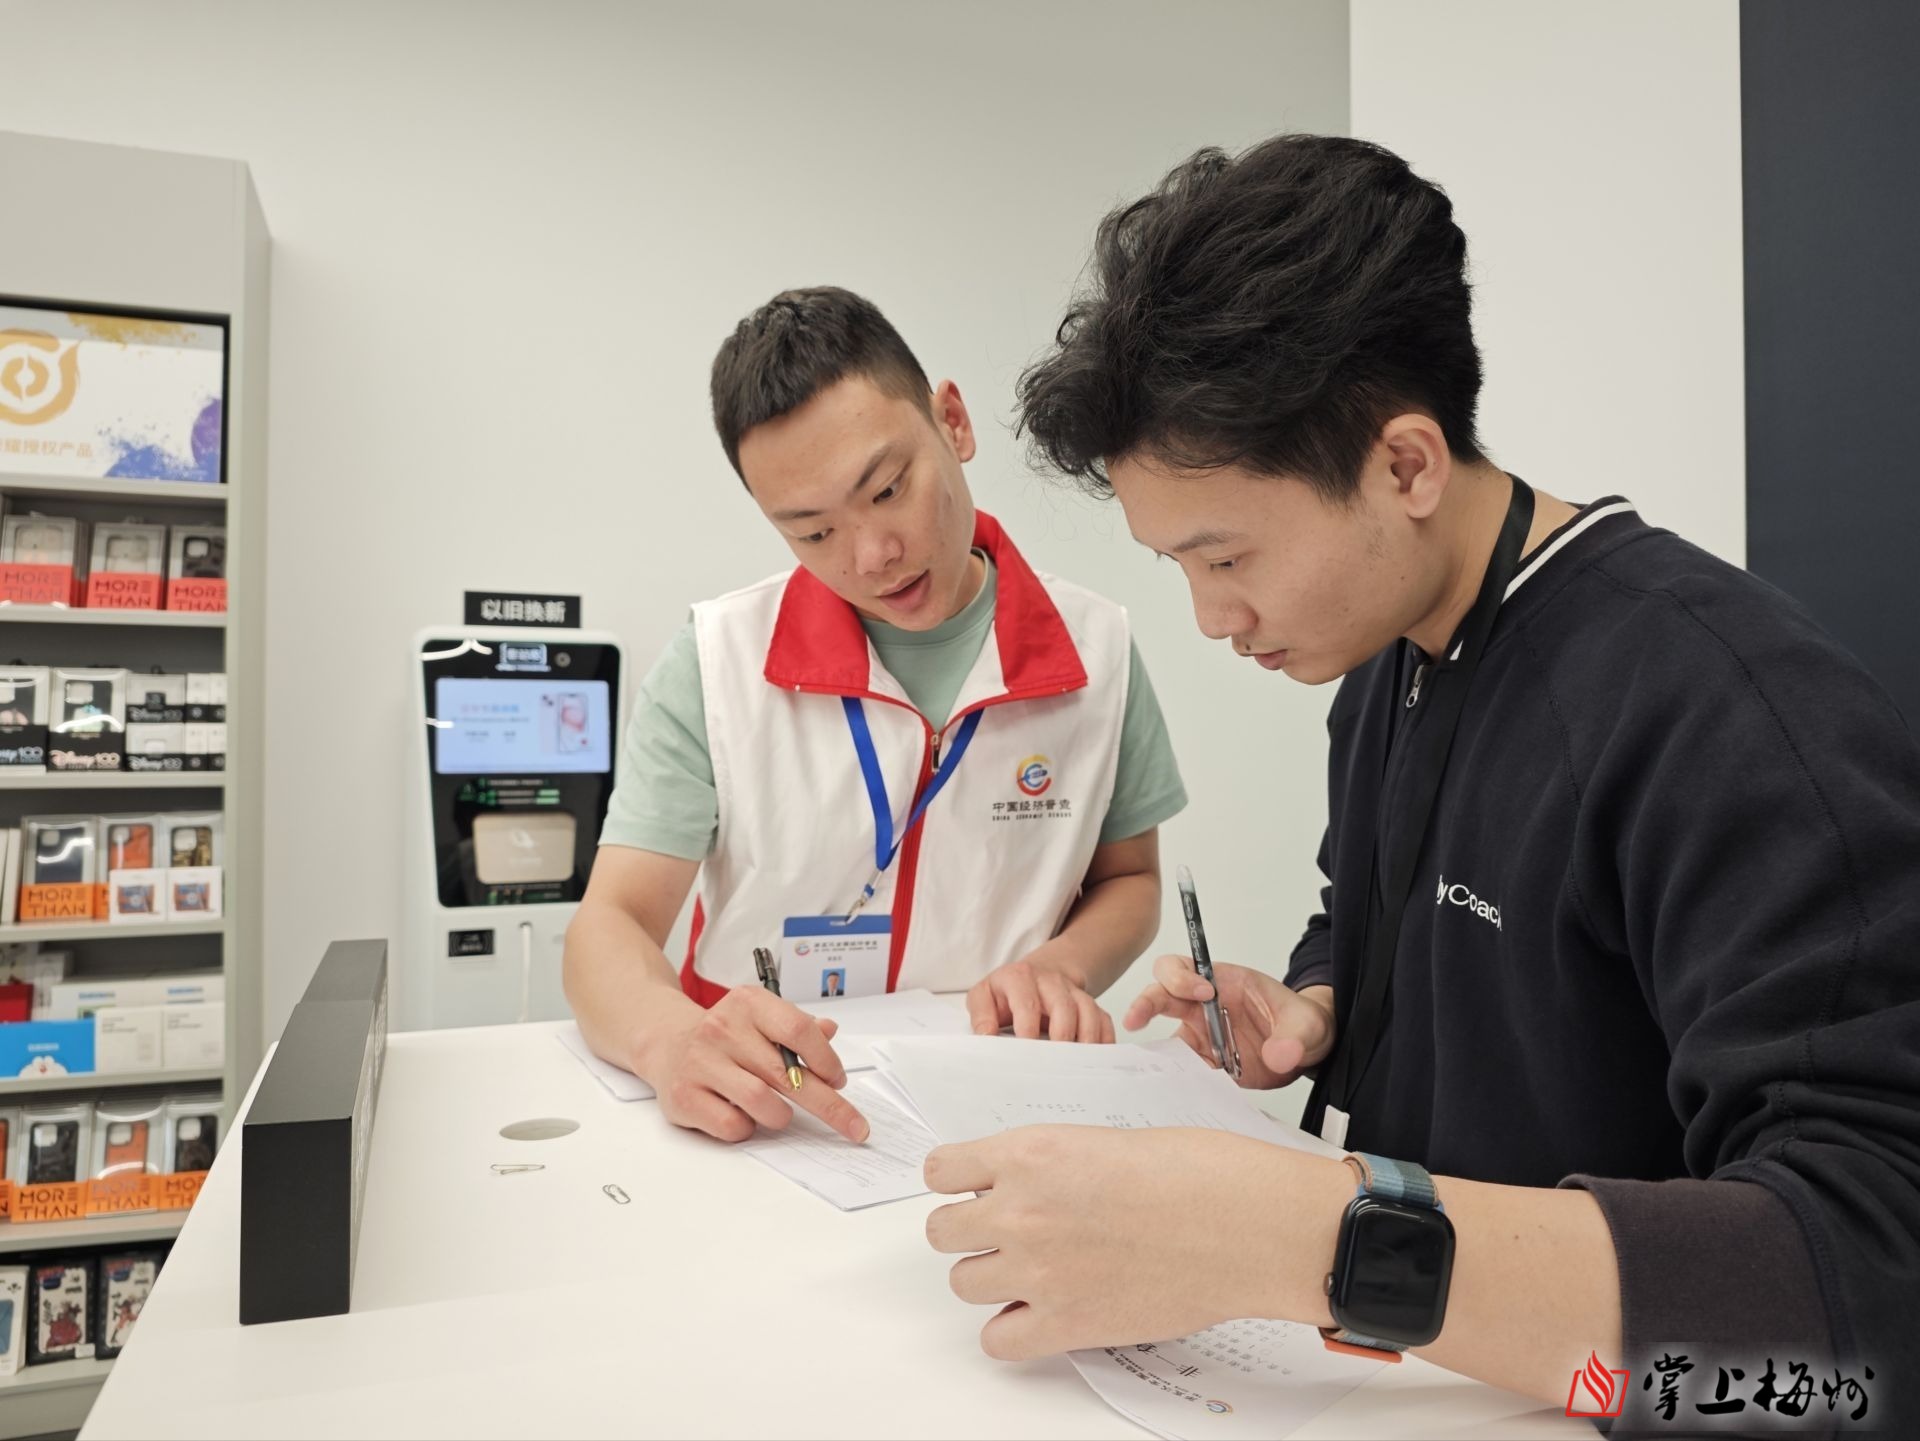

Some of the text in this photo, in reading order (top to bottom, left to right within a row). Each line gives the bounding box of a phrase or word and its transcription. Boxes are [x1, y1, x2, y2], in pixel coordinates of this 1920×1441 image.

[0, 438, 93, 458] 耀授权产品
[4, 571, 64, 585] MORE
[4, 587, 63, 600] THAN
[95, 580, 153, 593] MORE
[96, 594, 151, 608] THAN
[480, 599, 567, 623] 以旧换新
[28, 888, 83, 900] MORE
[29, 904, 87, 916] THAN
[166, 1175, 206, 1192] MO
[20, 1187, 79, 1204] MORE
[93, 1195, 150, 1211] THAN
[20, 1204, 78, 1220] THAN
